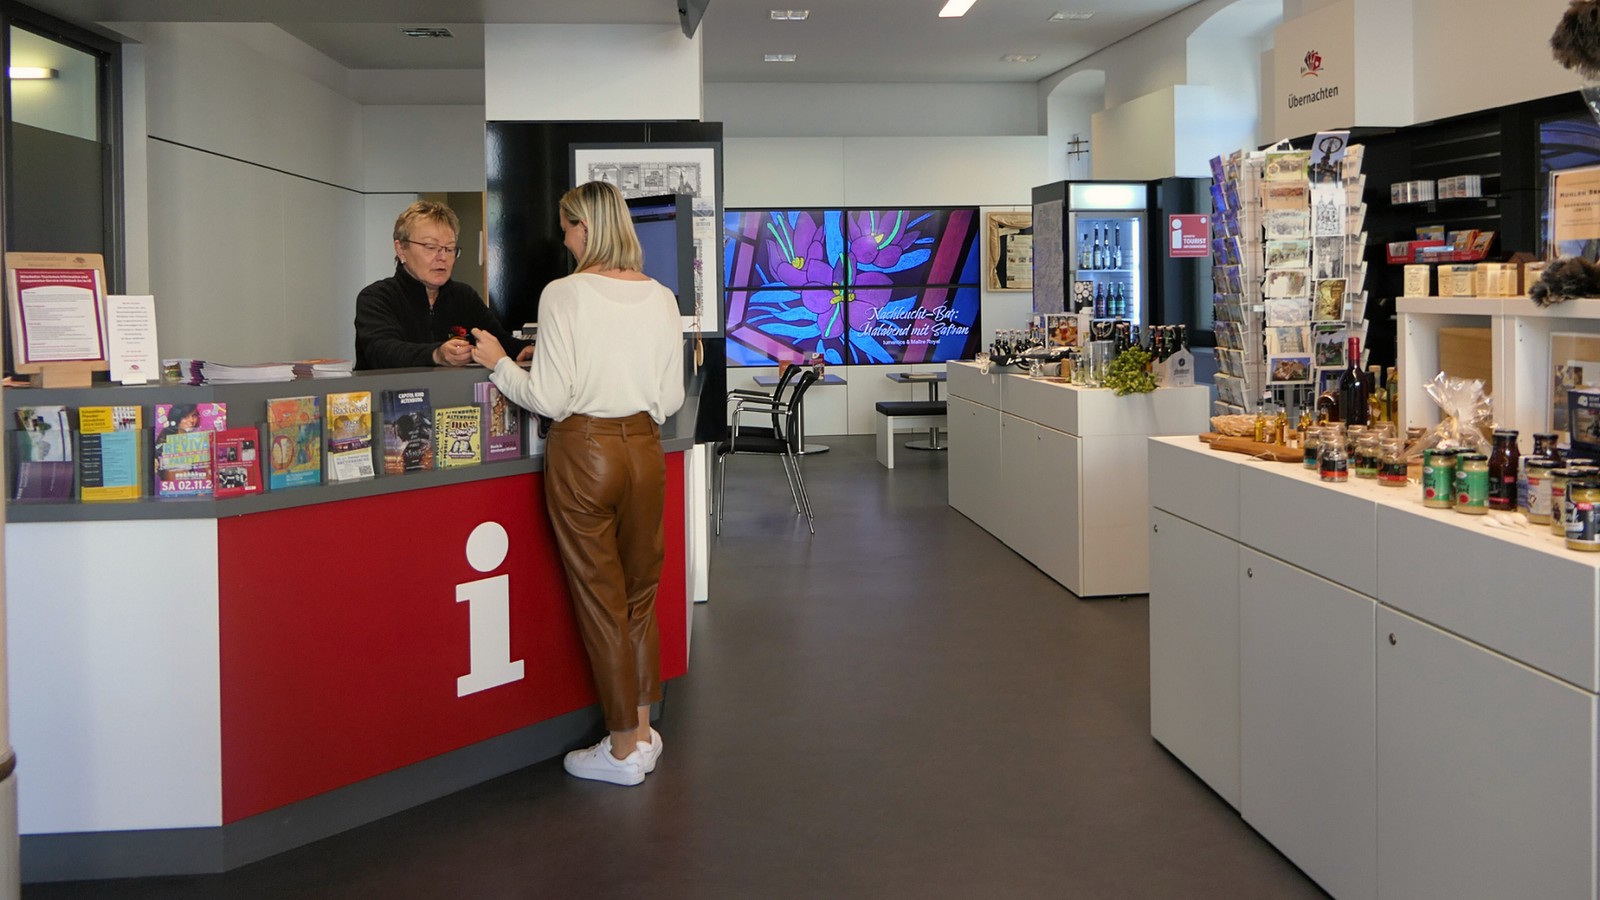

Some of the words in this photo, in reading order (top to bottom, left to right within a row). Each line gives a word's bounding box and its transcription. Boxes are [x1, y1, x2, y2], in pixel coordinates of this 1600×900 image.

[1287, 86, 1339, 109] Übernachten
[910, 323, 929, 336] mit
[931, 322, 970, 337] Safran
[164, 441, 209, 455] REVIVA
[162, 481, 176, 491] SA
[178, 479, 213, 490] 02.11.2
